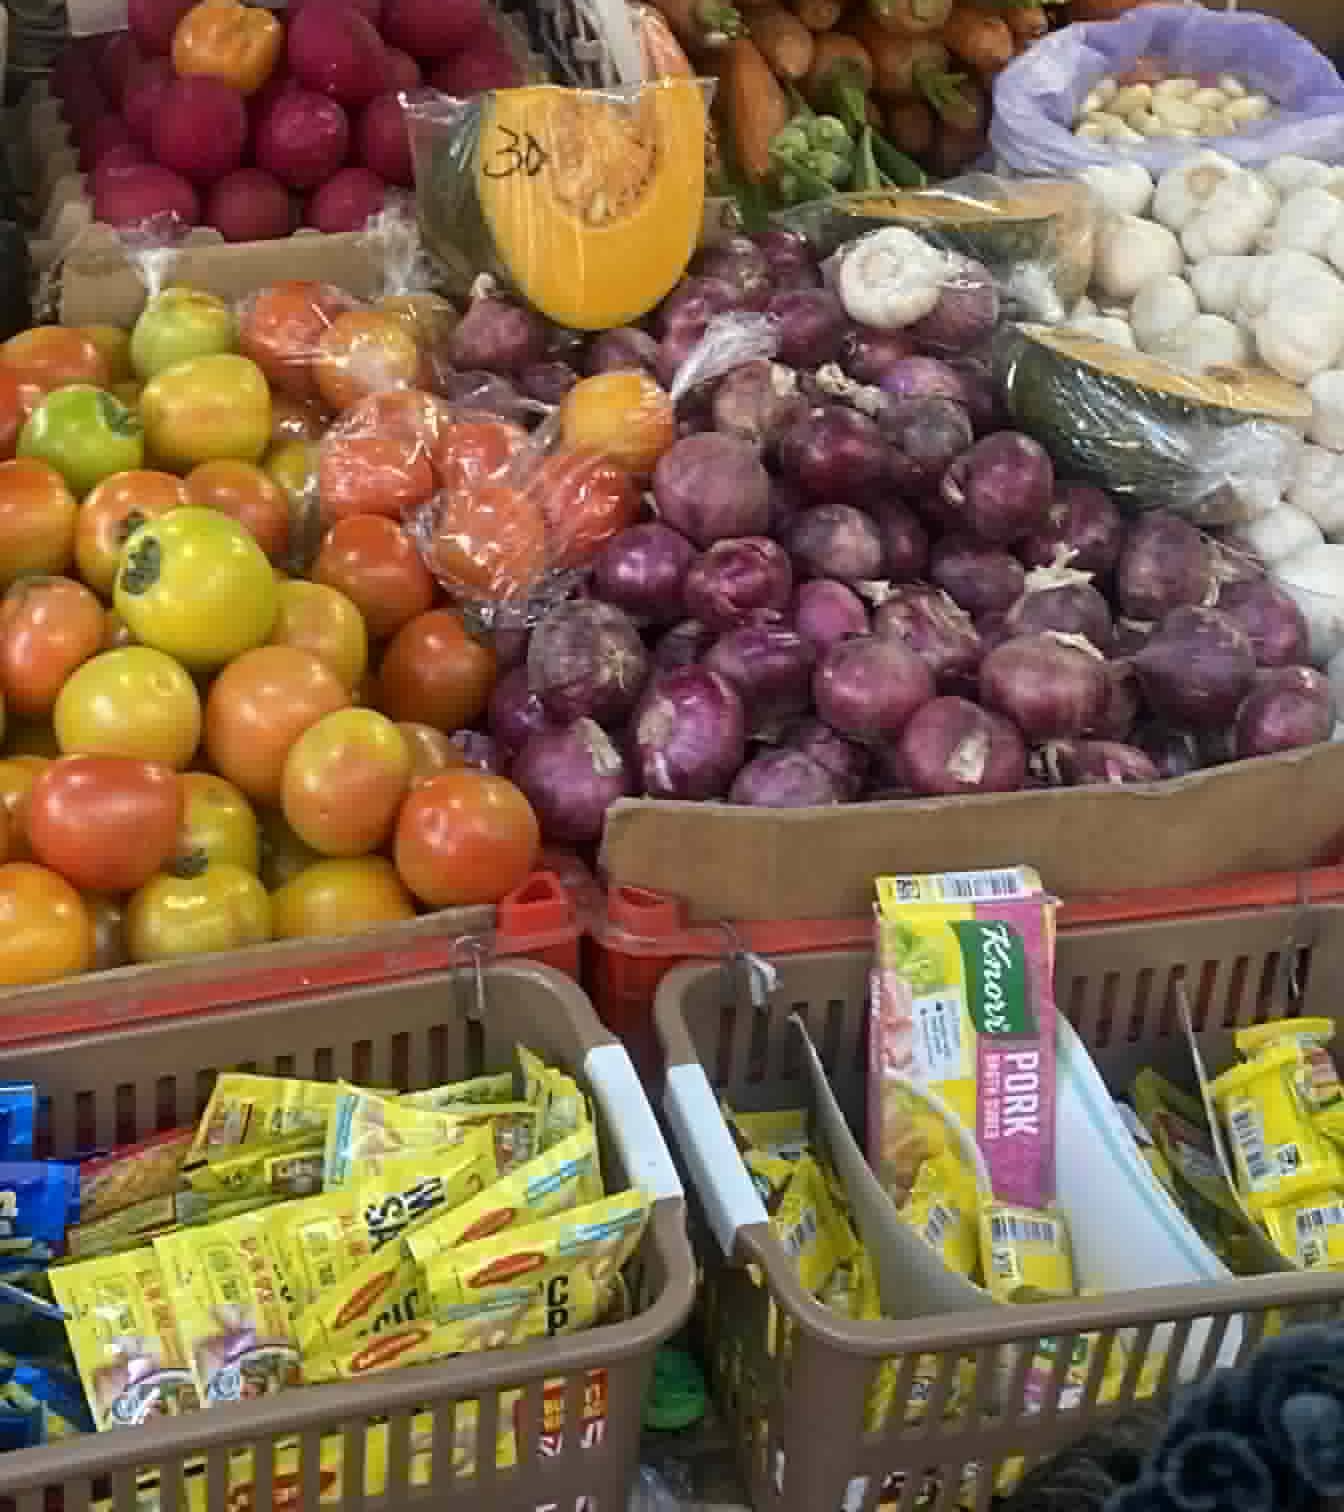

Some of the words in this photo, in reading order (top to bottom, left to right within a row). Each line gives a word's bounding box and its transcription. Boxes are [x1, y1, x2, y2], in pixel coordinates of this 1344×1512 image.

[482, 123, 551, 178] 30
[977, 922, 1016, 1036] Knorr
[1004, 1049, 1042, 1140] PORK
